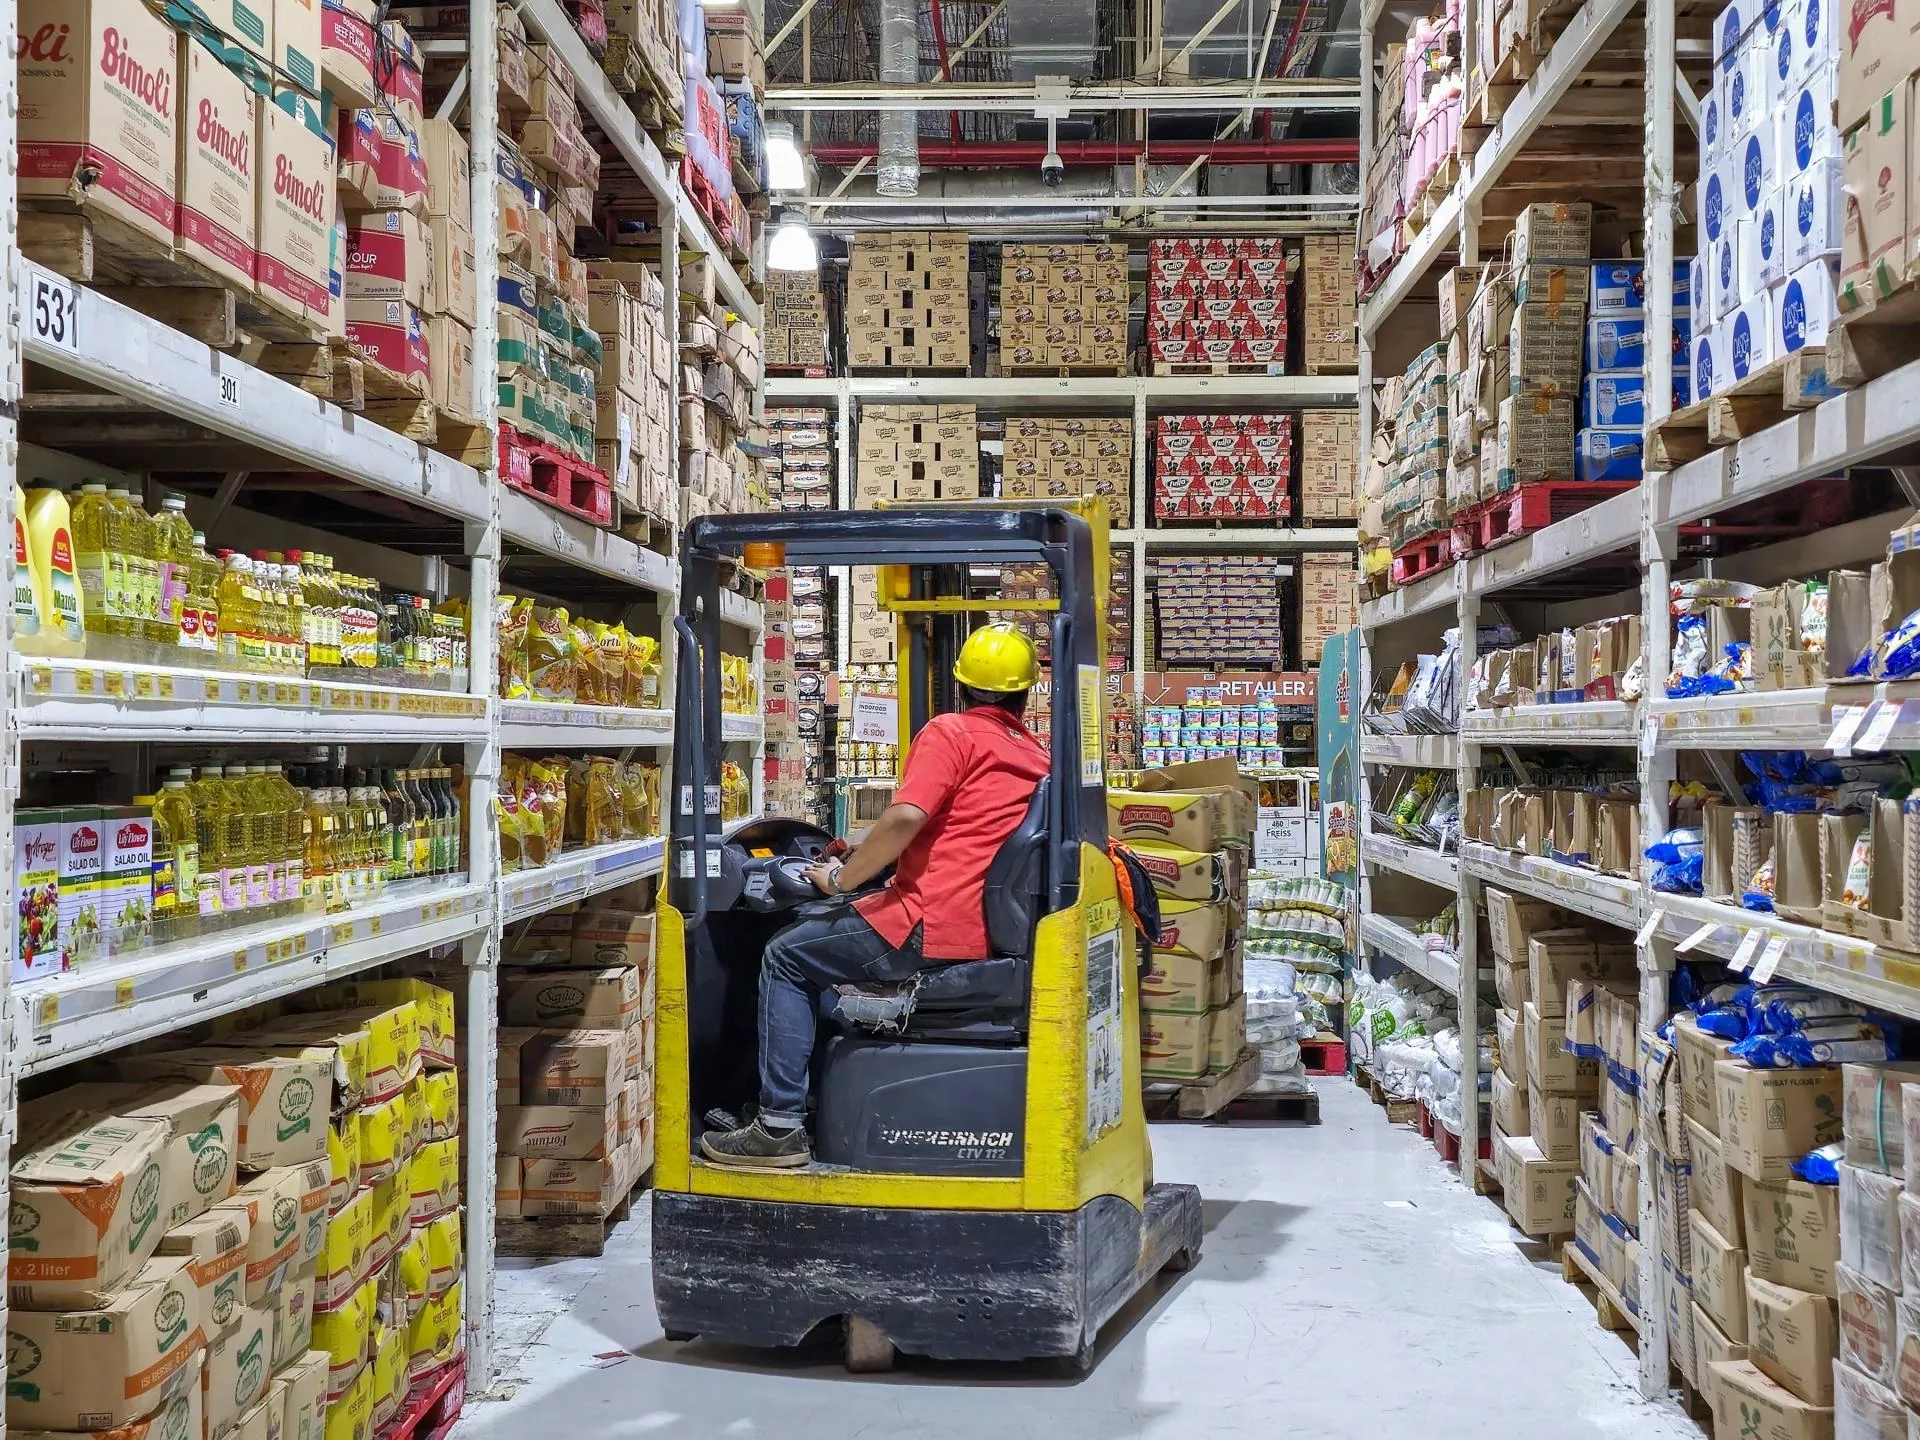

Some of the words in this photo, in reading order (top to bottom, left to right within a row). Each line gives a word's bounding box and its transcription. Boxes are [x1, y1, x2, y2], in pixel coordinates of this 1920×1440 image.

[101, 27, 170, 118] Bimoli
[197, 98, 248, 176] Bimoli
[274, 153, 325, 224] Bimoli
[36, 281, 78, 347] 531
[221, 376, 237, 403] 301
[54, 589, 77, 612] Mazola
[1219, 680, 1305, 697] RETAILER
[1272, 820, 1284, 828] 460
[118, 832, 128, 845] Lily
[69, 859, 88, 871] SALAD
[89, 857, 100, 868] OIL
[114, 853, 136, 866] SALAD
[137, 852, 150, 863] OIL
[1763, 1078, 1788, 1087] WHEAT
[526, 1135, 567, 1147] Fortune
[881, 1129, 1013, 1147] HEINRICH
[957, 1148, 982, 1159] ETV
[985, 1148, 1004, 1159] 112
[27, 1264, 36, 1275] 2
[41, 1262, 71, 1276] liter
[80, 1316, 87, 1327] 7
